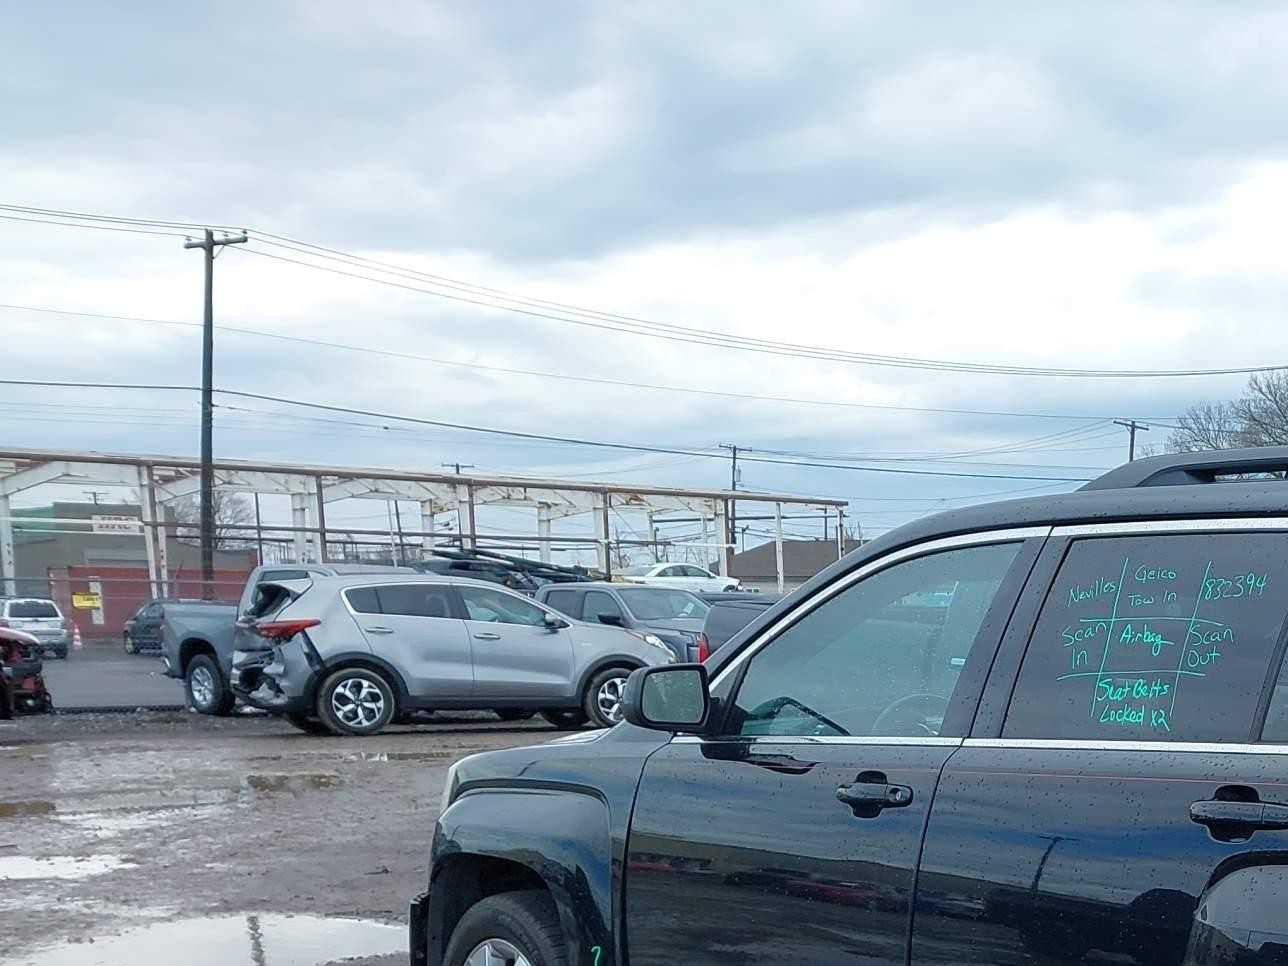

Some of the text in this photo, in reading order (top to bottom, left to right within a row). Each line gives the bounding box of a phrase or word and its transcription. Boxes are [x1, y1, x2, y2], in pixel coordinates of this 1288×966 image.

[1134, 564, 1177, 584] Geico
[1204, 572, 1268, 601] 832394
[1128, 593, 1155, 607] Tow
[1061, 621, 1108, 647] Scan
[1119, 623, 1175, 656] Airbag
[1190, 624, 1234, 646] Scan
[1071, 648, 1089, 670] In
[1186, 645, 1222, 668] Out
[1099, 702, 1145, 727] Locked
